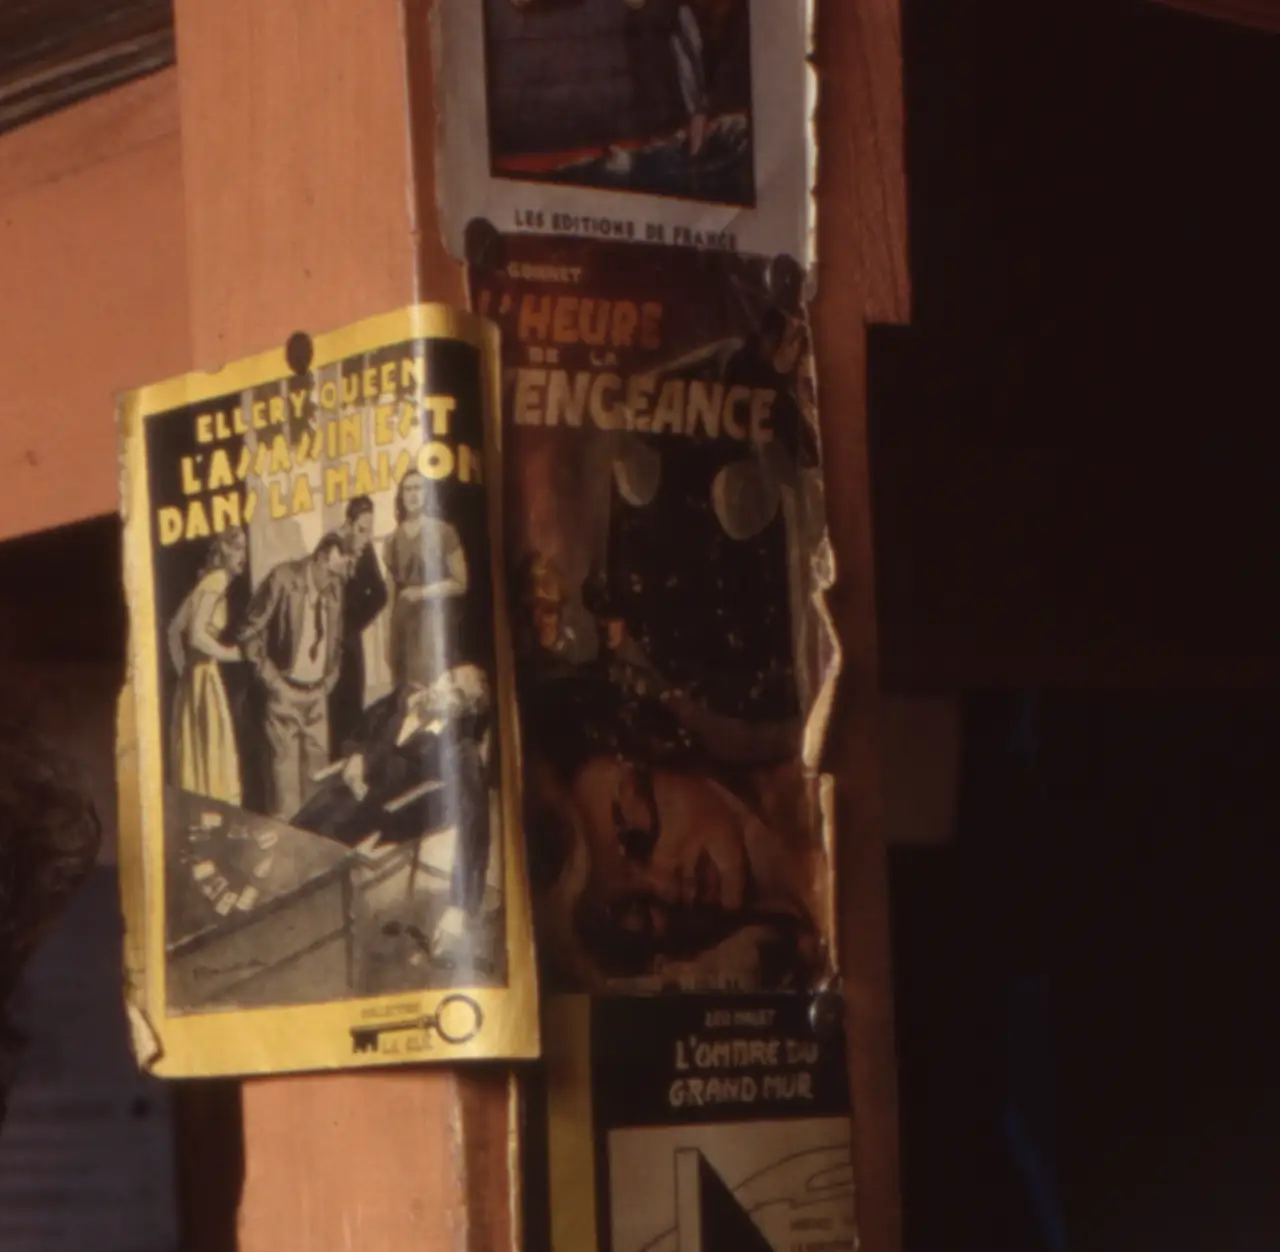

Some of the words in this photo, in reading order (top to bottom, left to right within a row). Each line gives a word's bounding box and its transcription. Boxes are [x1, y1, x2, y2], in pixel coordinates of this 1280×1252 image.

[515, 208, 544, 228] LES
[552, 212, 635, 238] EDITIONS
[646, 222, 665, 241] DE
[196, 387, 309, 444] ELLERY
[321, 356, 425, 411] QUEEN
[375, 395, 457, 447] EST
[512, 367, 778, 443] ENGEANCE
[157, 487, 258, 548] DANS
[269, 473, 315, 521] LA
[675, 1034, 782, 1071] L'OMBRE
[786, 1038, 820, 1066] DU
[668, 1075, 758, 1108] GRAND
[762, 1071, 815, 1101] MUR
